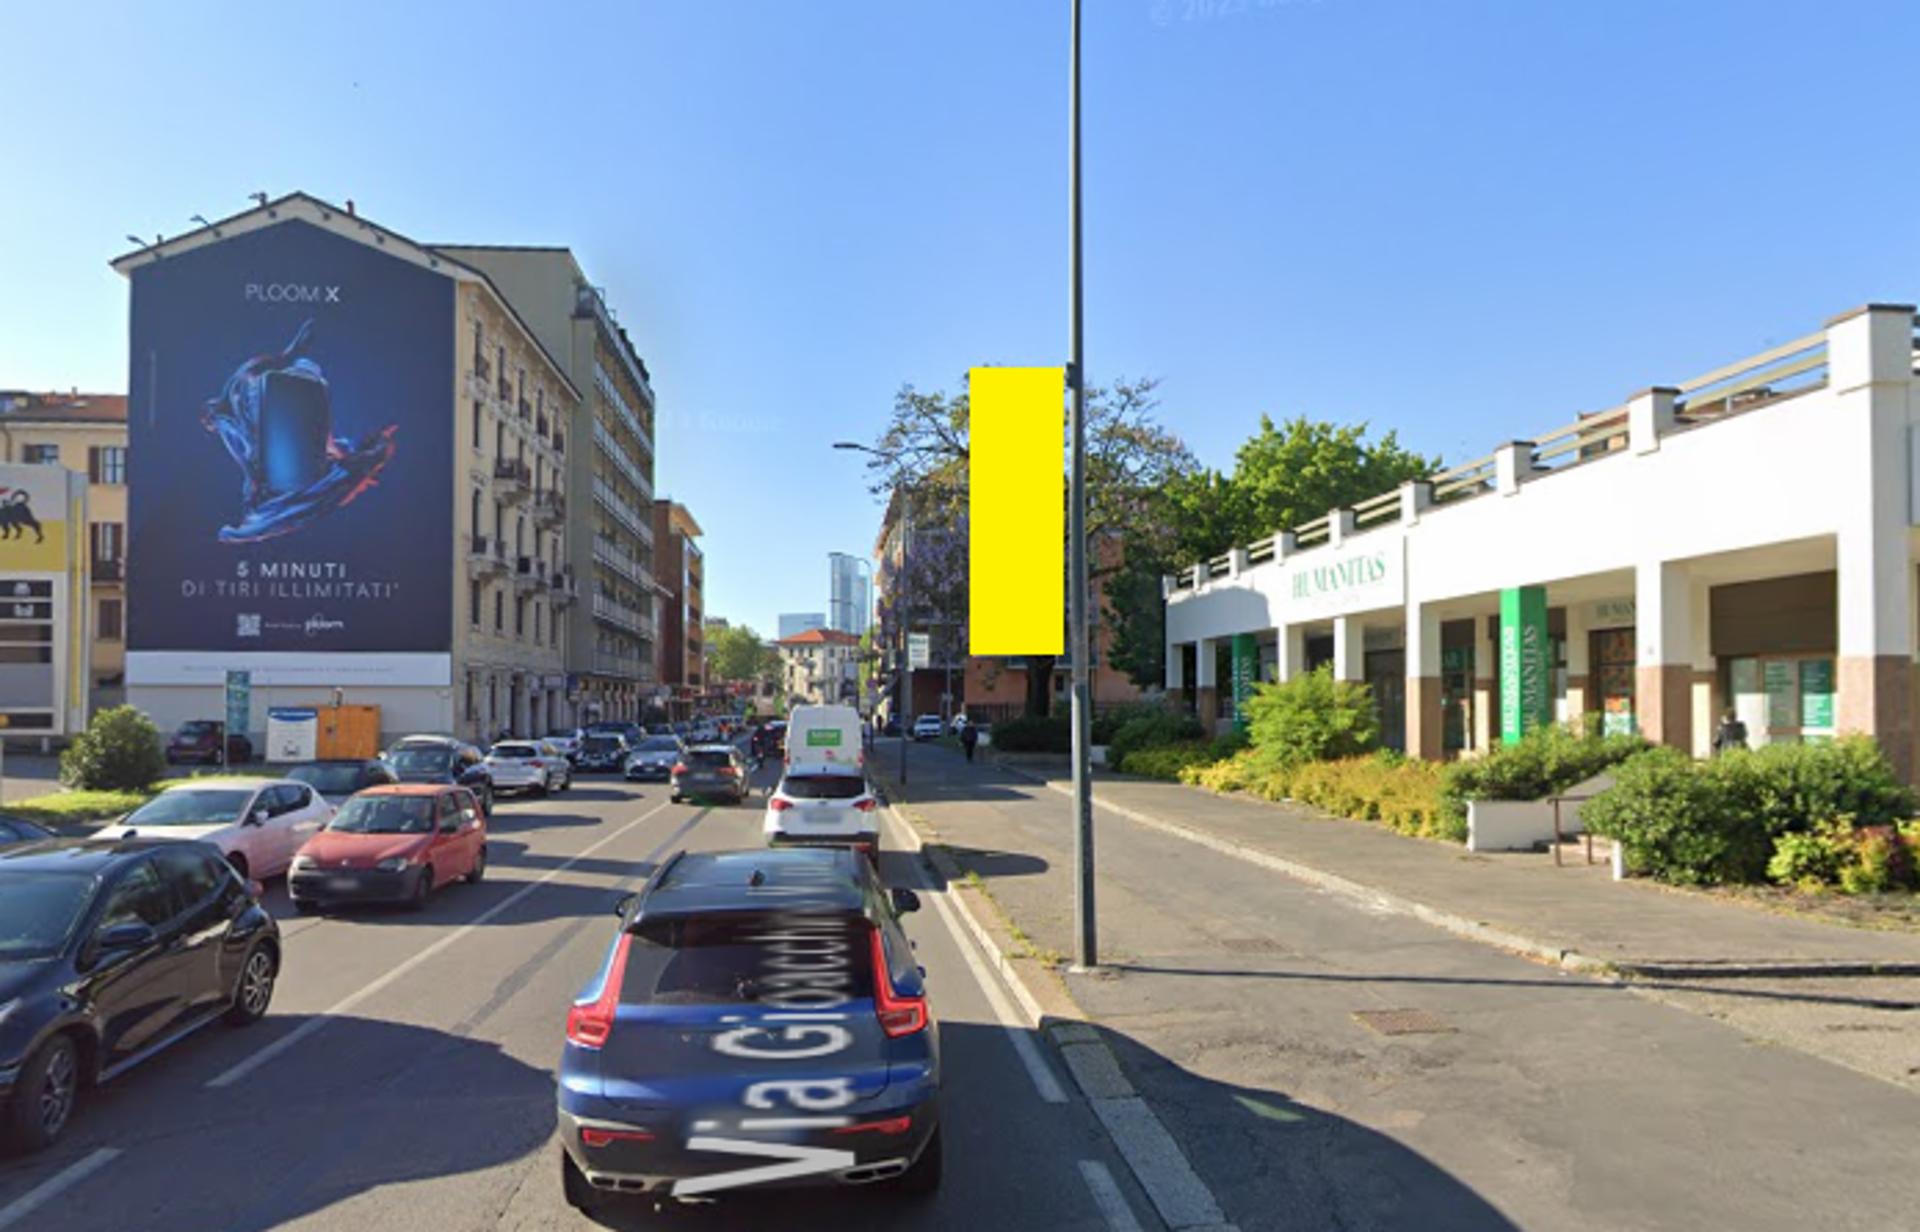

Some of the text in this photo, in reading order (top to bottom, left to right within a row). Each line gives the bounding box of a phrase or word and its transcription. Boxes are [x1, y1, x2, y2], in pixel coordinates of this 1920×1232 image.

[245, 283, 340, 302] PLOOM X
[237, 562, 347, 578] 5 MINUTI
[1292, 553, 1386, 600] HUMANITAS
[181, 580, 205, 598] DI
[215, 581, 259, 598] TIRI
